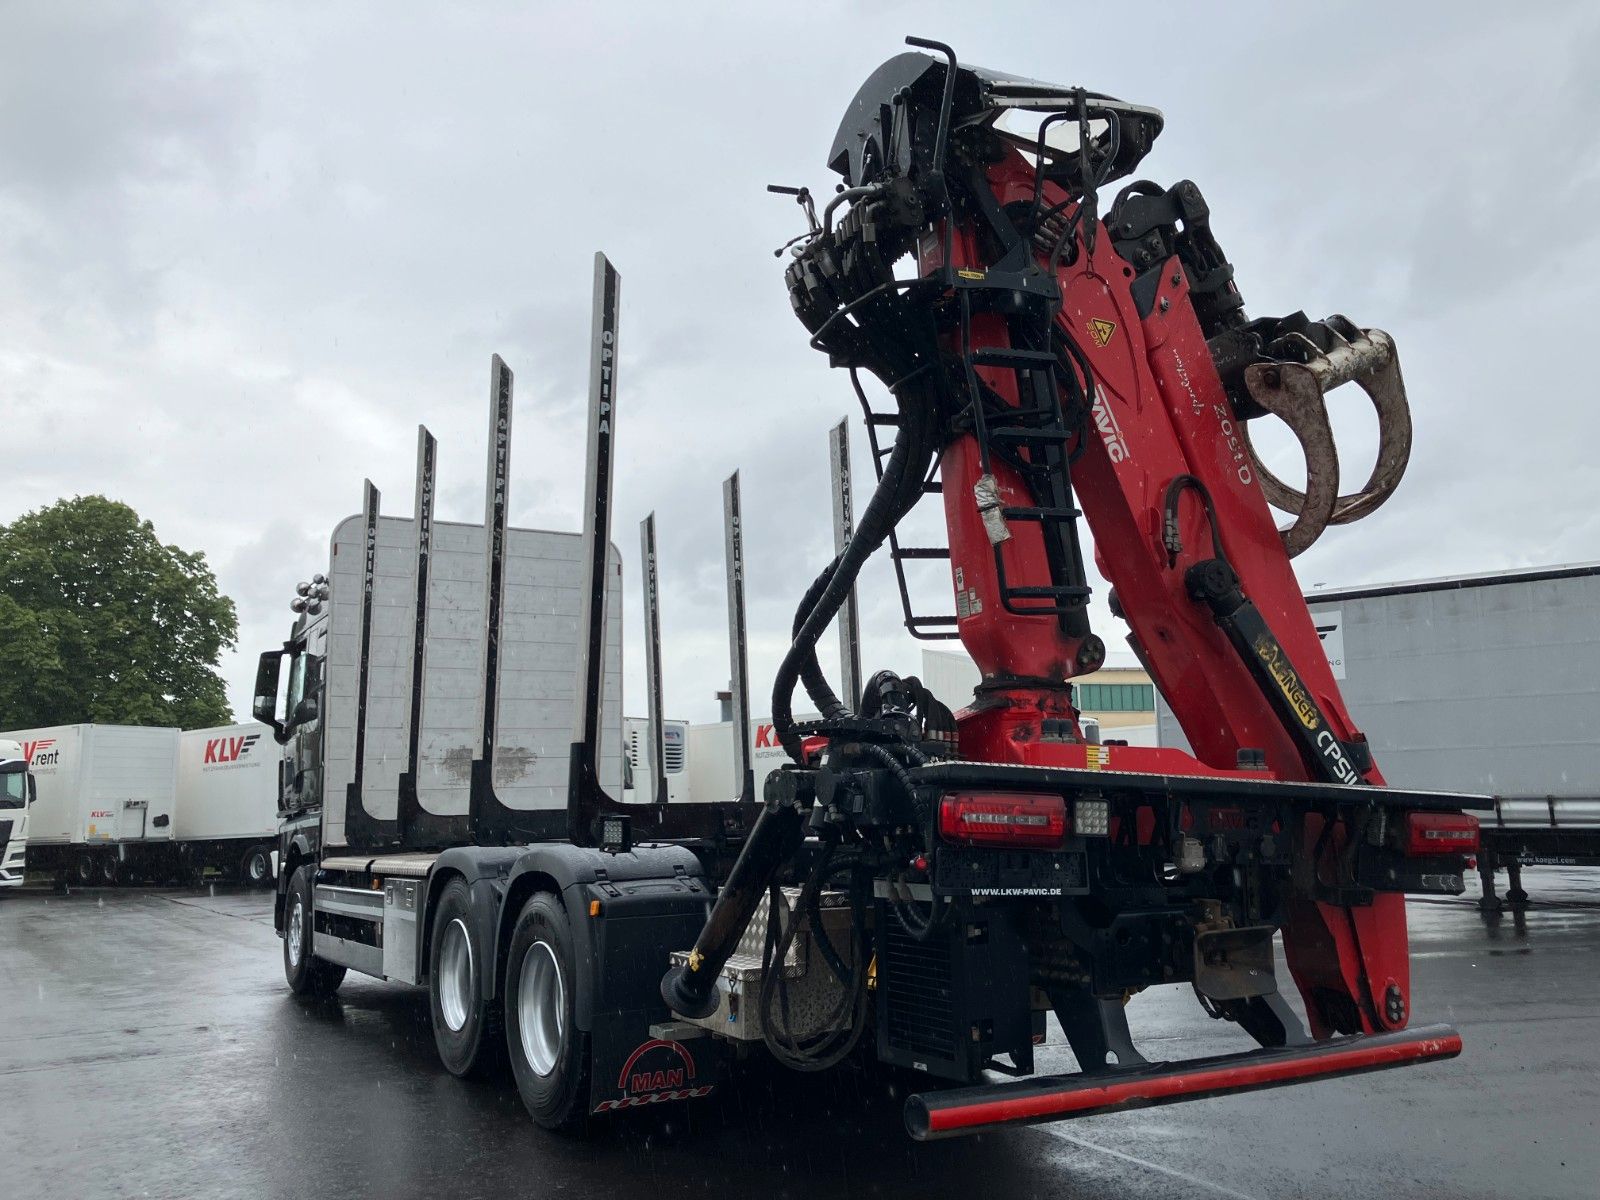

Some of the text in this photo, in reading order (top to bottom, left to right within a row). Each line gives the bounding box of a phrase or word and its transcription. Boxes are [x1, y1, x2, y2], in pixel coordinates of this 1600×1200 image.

[599, 331, 614, 434] OPTIPA
[204, 735, 245, 764] KLV
[1516, 856, 1576, 865] www.koegel.com
[971, 888, 1062, 896] WWW.LKW-PAVIC.DE
[631, 1068, 684, 1093] MAN
